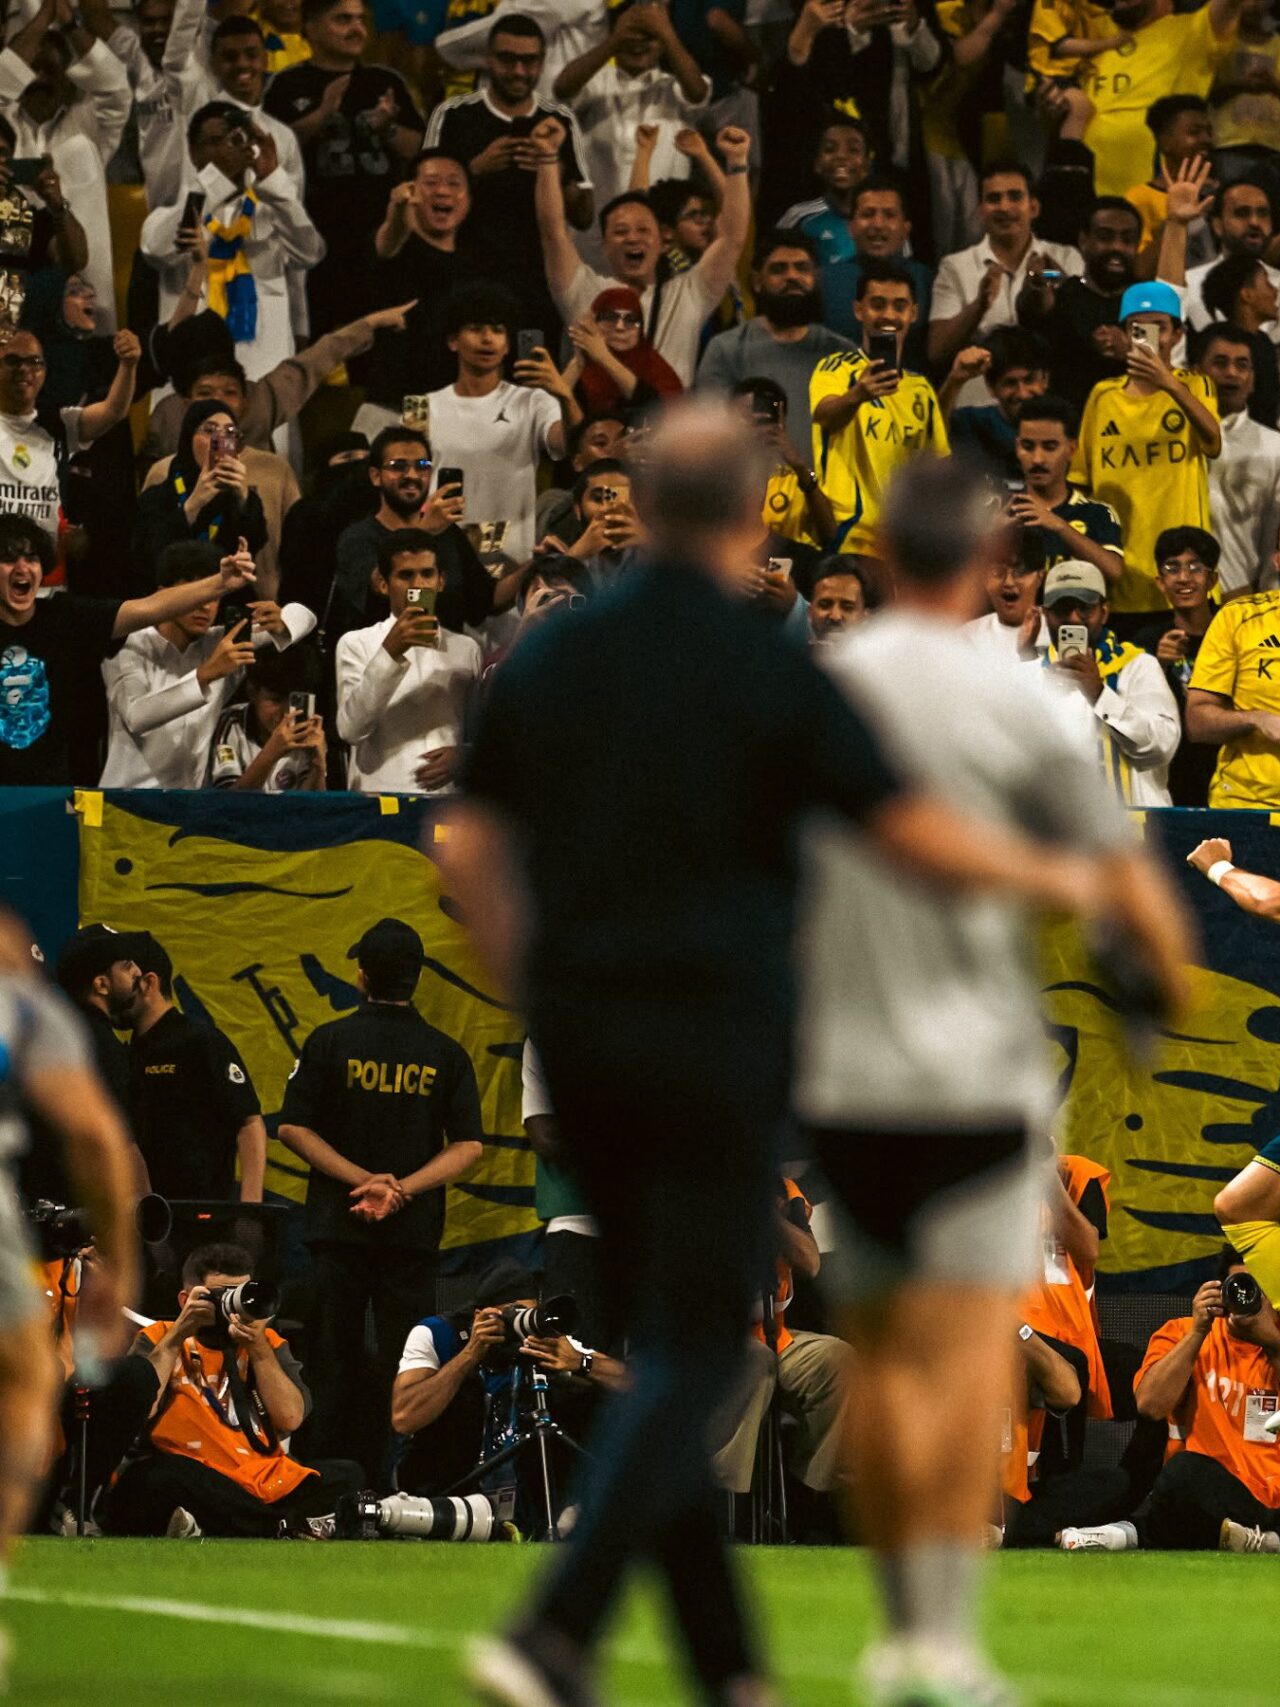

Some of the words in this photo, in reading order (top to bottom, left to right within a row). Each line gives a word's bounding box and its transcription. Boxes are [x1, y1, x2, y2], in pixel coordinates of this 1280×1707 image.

[1093, 72, 1131, 95] FD
[1101, 440, 1186, 469] KAFD
[0, 481, 58, 502] mirates
[144, 1063, 176, 1075] POLICE
[348, 1058, 437, 1097] POLICE
